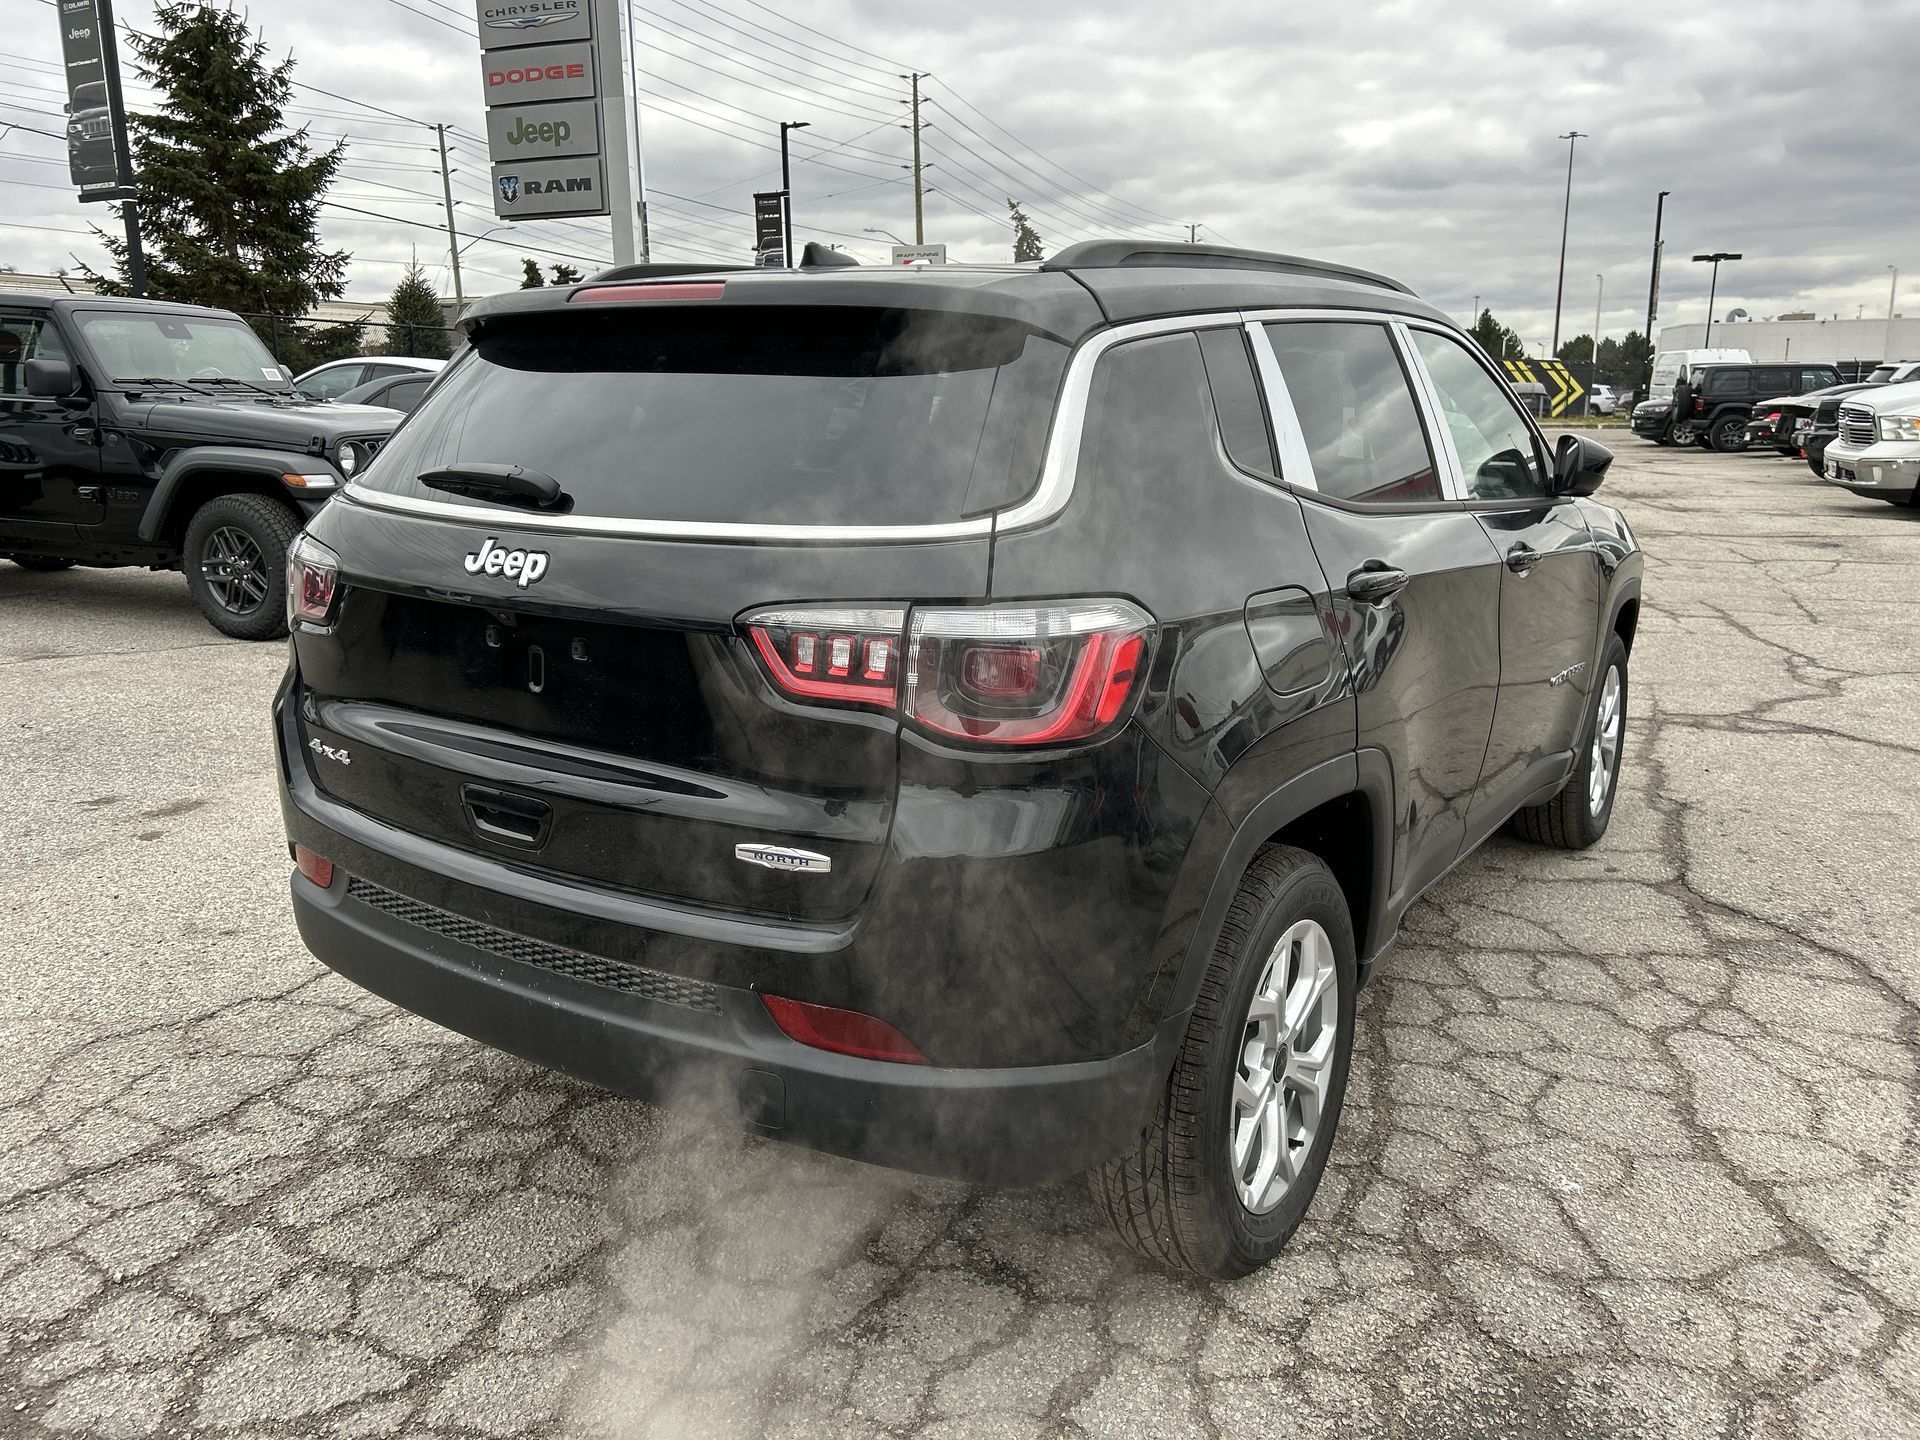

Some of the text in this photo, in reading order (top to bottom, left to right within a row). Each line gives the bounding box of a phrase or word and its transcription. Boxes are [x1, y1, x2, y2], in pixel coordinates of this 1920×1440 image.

[485, 0, 577, 18] CHRYSLER
[69, 28, 90, 39] Jeep
[488, 64, 584, 86] DODGE
[507, 117, 571, 146] Jeep
[524, 178, 592, 195] RAM
[464, 536, 550, 590] Jeep
[308, 737, 351, 766] 4x4
[753, 852, 809, 867] NORTH
